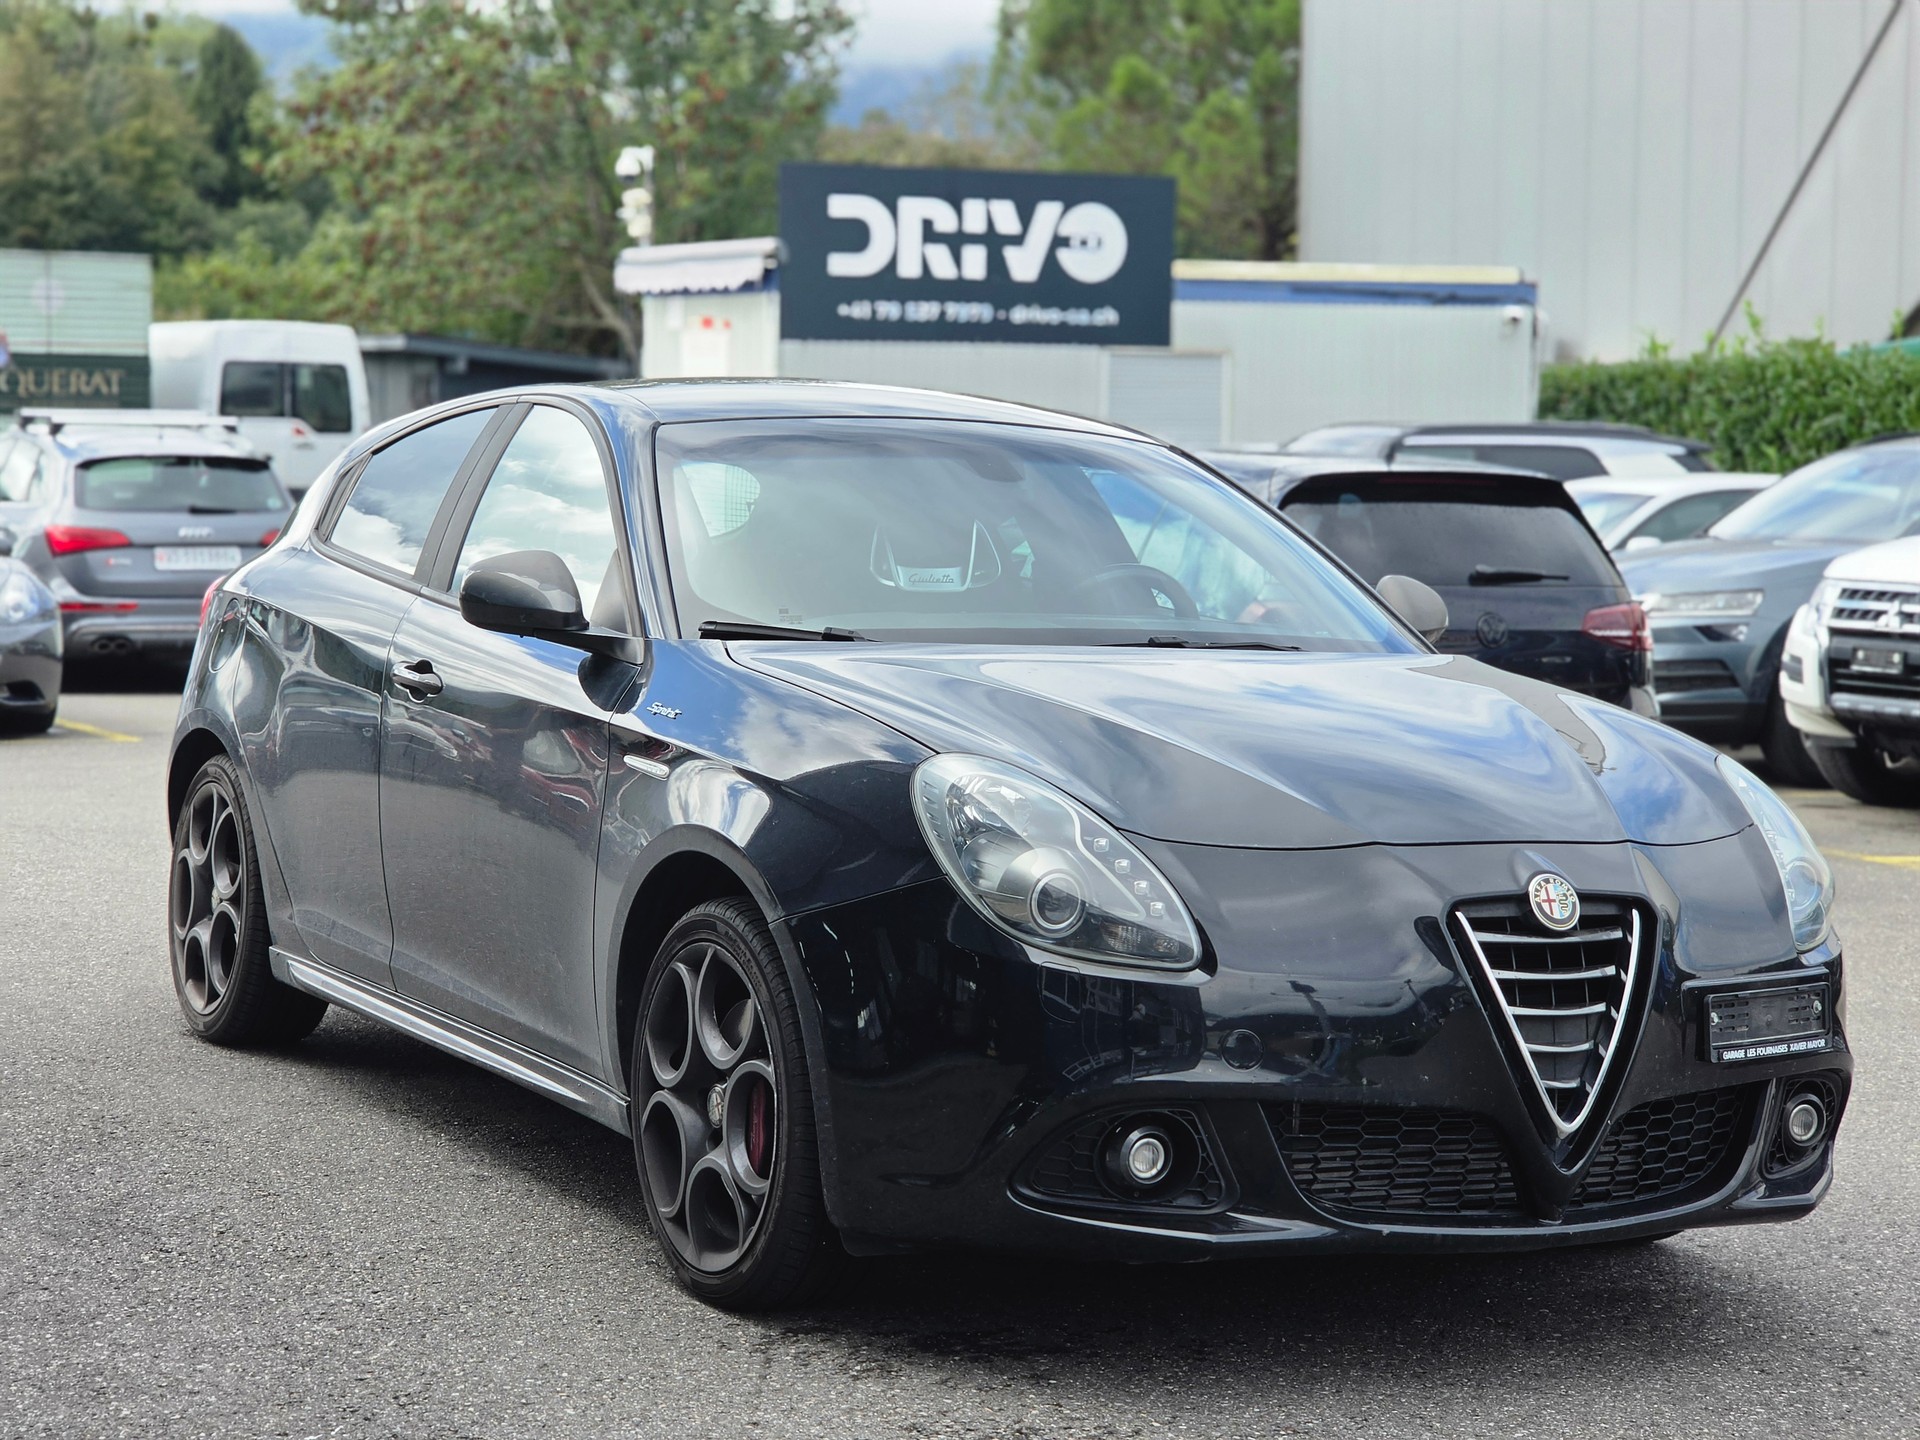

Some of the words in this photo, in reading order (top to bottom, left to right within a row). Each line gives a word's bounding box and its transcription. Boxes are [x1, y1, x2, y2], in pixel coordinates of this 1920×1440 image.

[827, 193, 1128, 283] DRIVO
[908, 573, 954, 584] Giulietta
[1535, 880, 1546, 902] ALFA
[1549, 878, 1575, 902] ROMEO
[1723, 1050, 1745, 1060] GARAGE
[1747, 1049, 1756, 1058] LES
[1790, 1042, 1806, 1052] XAVIER
